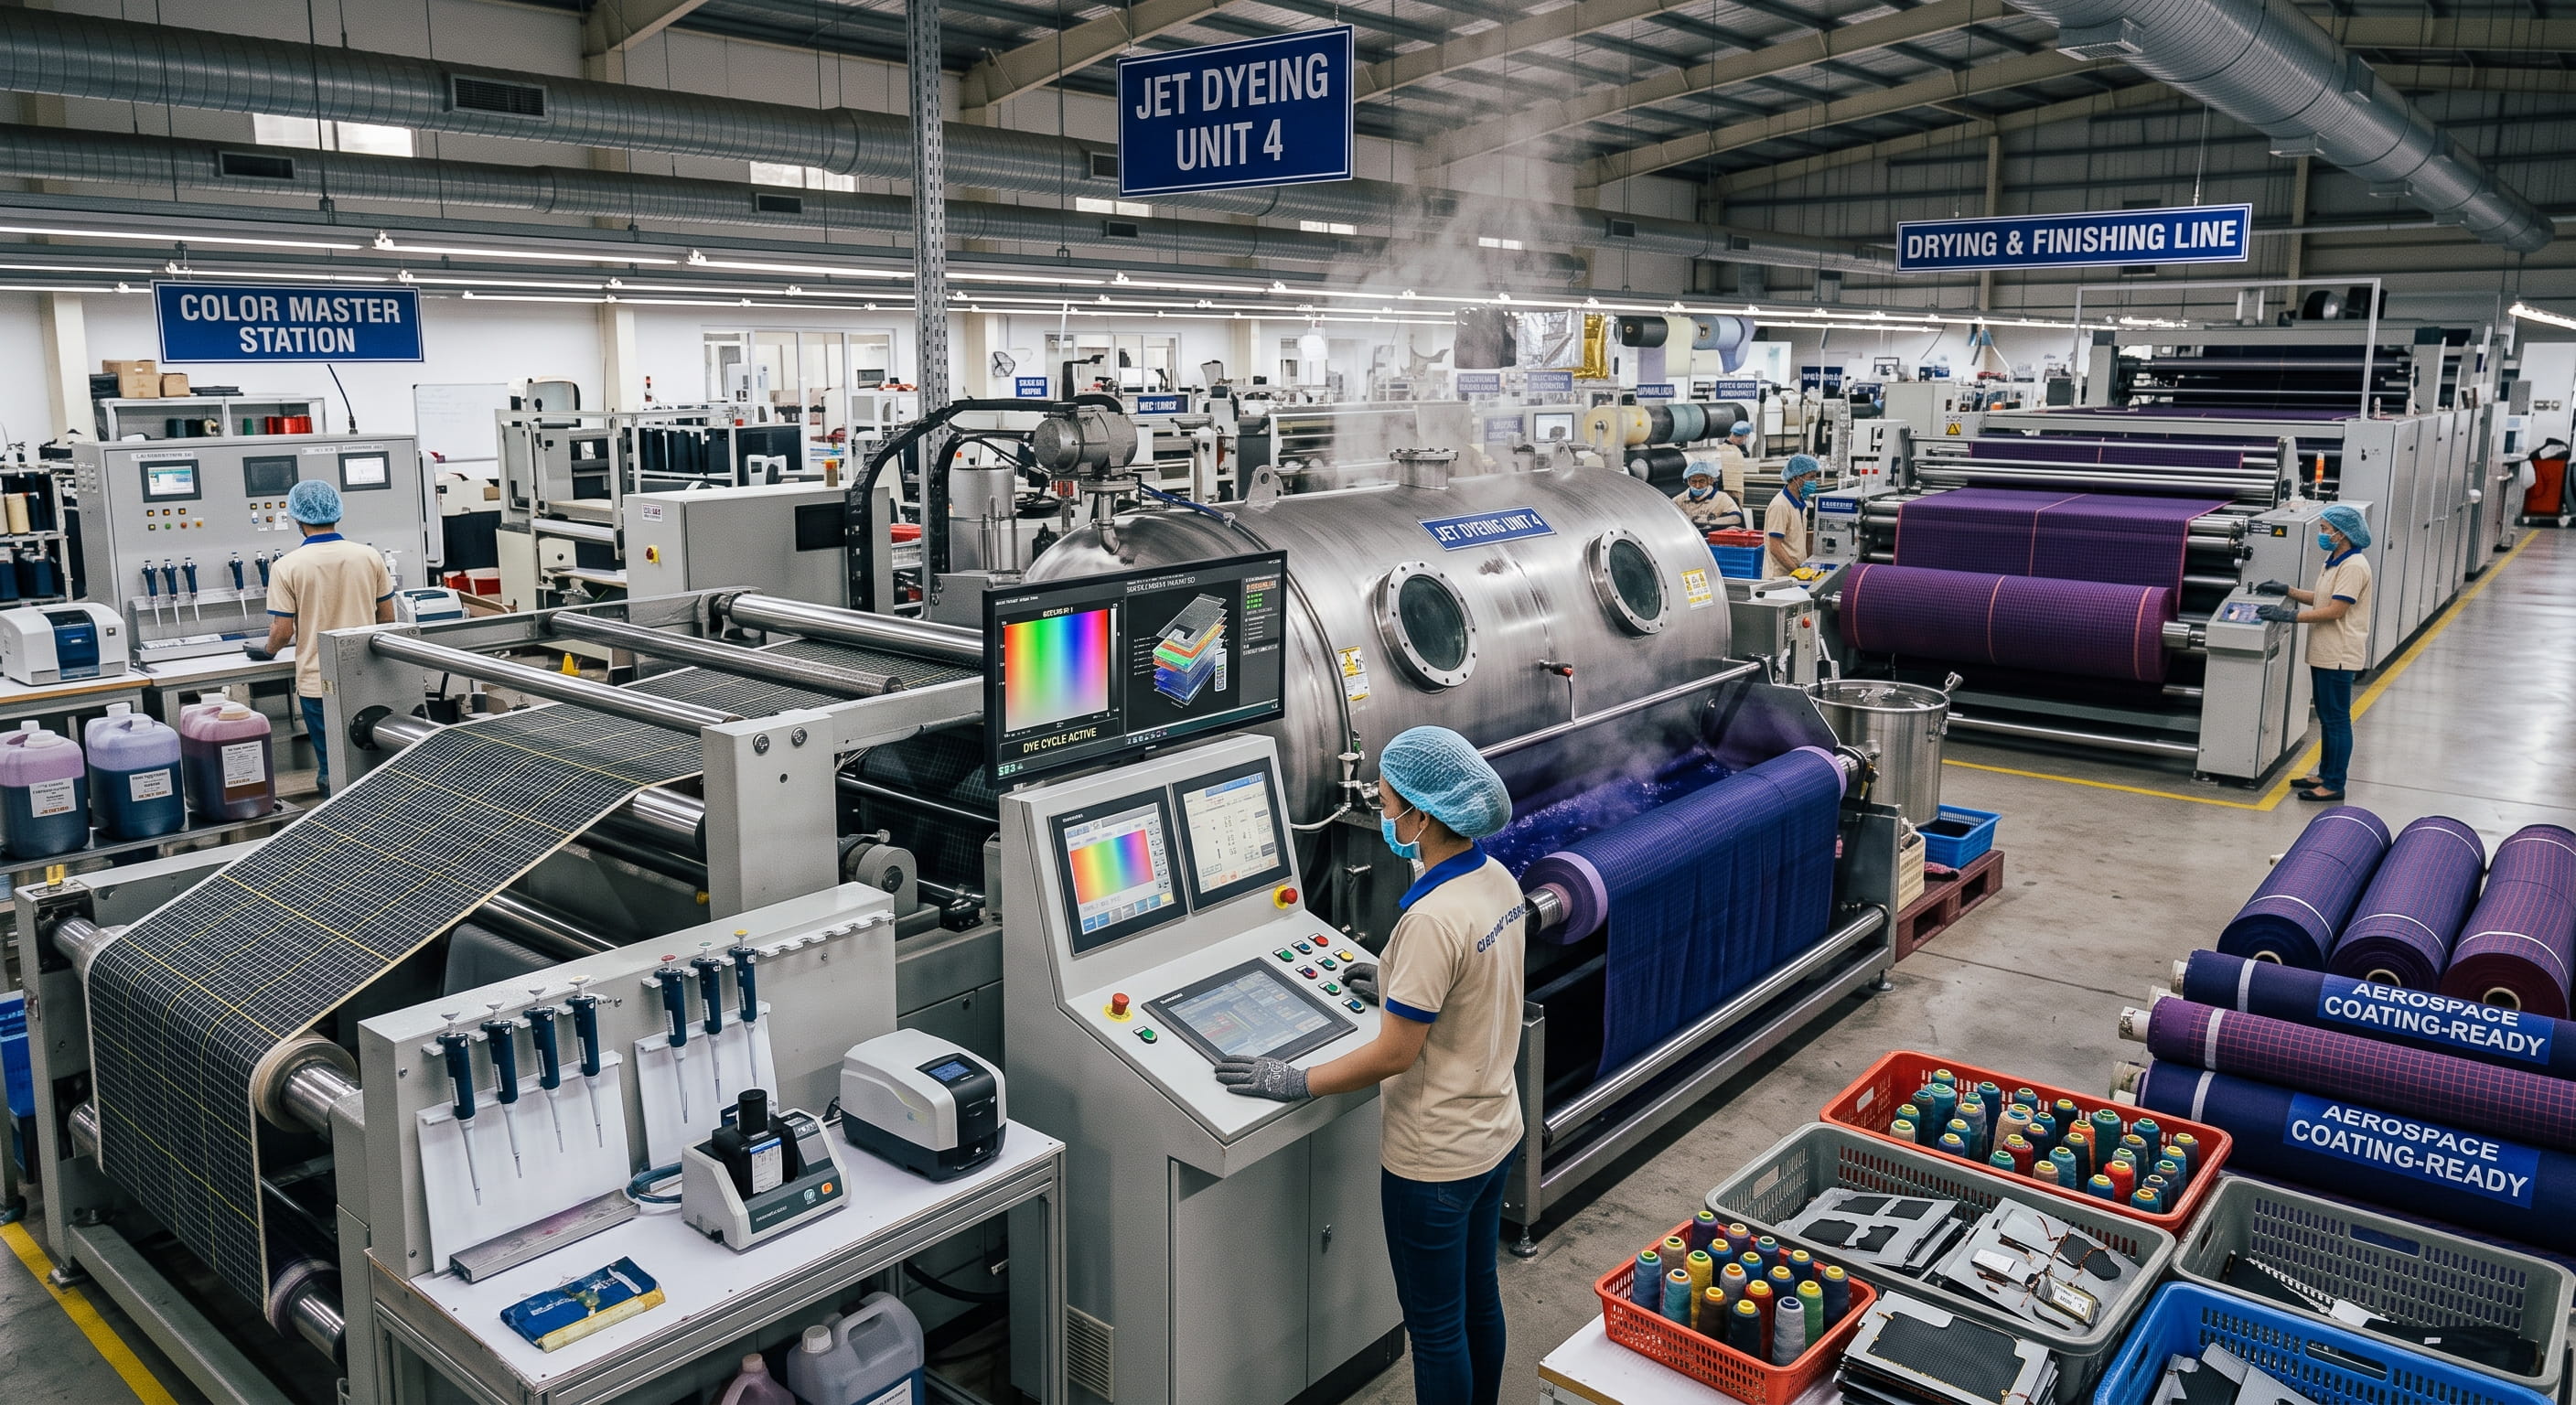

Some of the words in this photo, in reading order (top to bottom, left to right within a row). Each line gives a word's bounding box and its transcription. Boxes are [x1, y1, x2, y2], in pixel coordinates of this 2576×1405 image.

[1136, 71, 1191, 120] JET
[1202, 52, 1328, 112] DYEING
[1176, 122, 1253, 171] UNIT
[1263, 118, 1283, 161] 4
[1907, 231, 1997, 259] DRYING
[2005, 230, 2023, 256] &
[2033, 222, 2165, 254] FINISHING
[2174, 220, 2238, 249] LINE
[180, 294, 280, 322] COLOR
[289, 296, 401, 324] MASTER
[240, 327, 356, 353] STATION
[1434, 525, 1462, 542] JET
[1530, 513, 1543, 527] 4
[1023, 741, 1040, 754] DYE
[1041, 734, 1067, 749] CYCLE
[1068, 727, 1097, 743] ACTIVE
[2324, 995, 2546, 1056] COATING-READY
[2352, 982, 2519, 1027] AEROSPACE
[2322, 1105, 2500, 1162] AEROSPACE
[2292, 1119, 2529, 1198] COATING-READY
